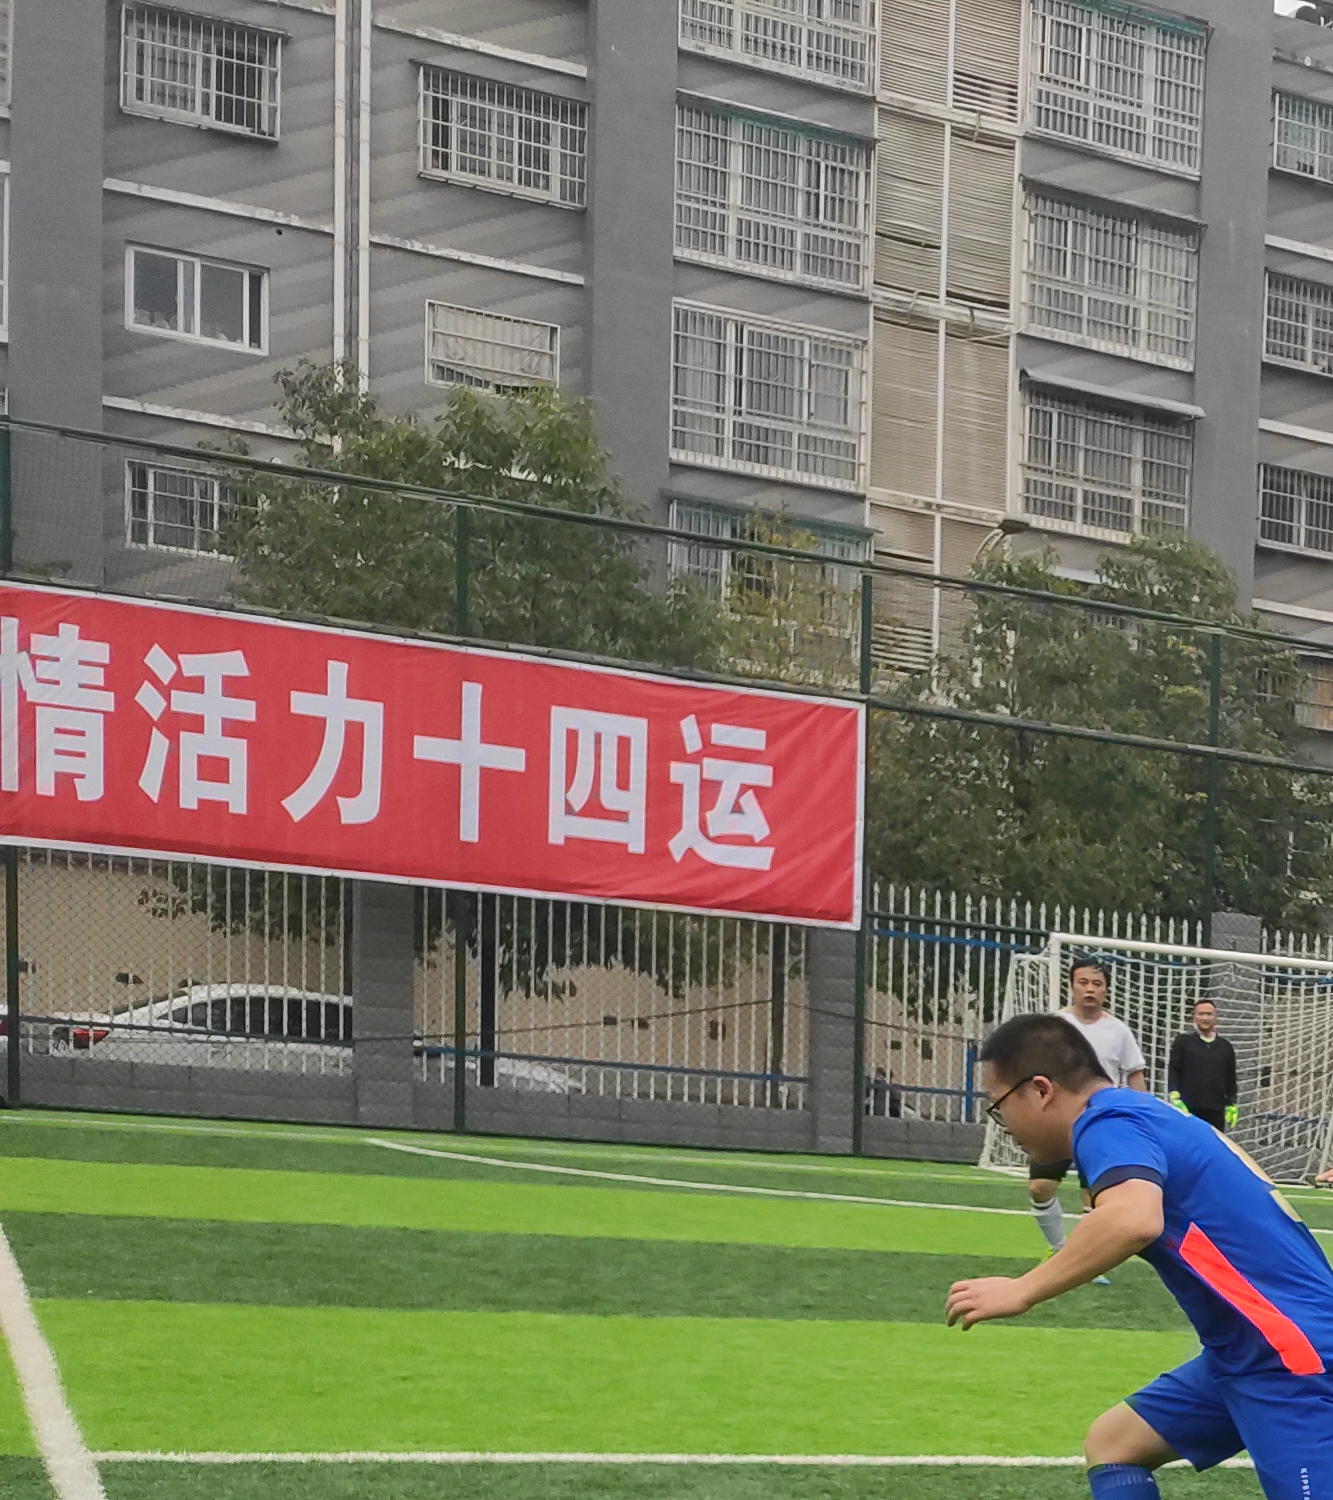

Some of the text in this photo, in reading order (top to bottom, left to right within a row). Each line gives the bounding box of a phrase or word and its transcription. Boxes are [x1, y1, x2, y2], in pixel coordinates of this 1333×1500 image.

[0, 615, 775, 870] 情活力十四运
